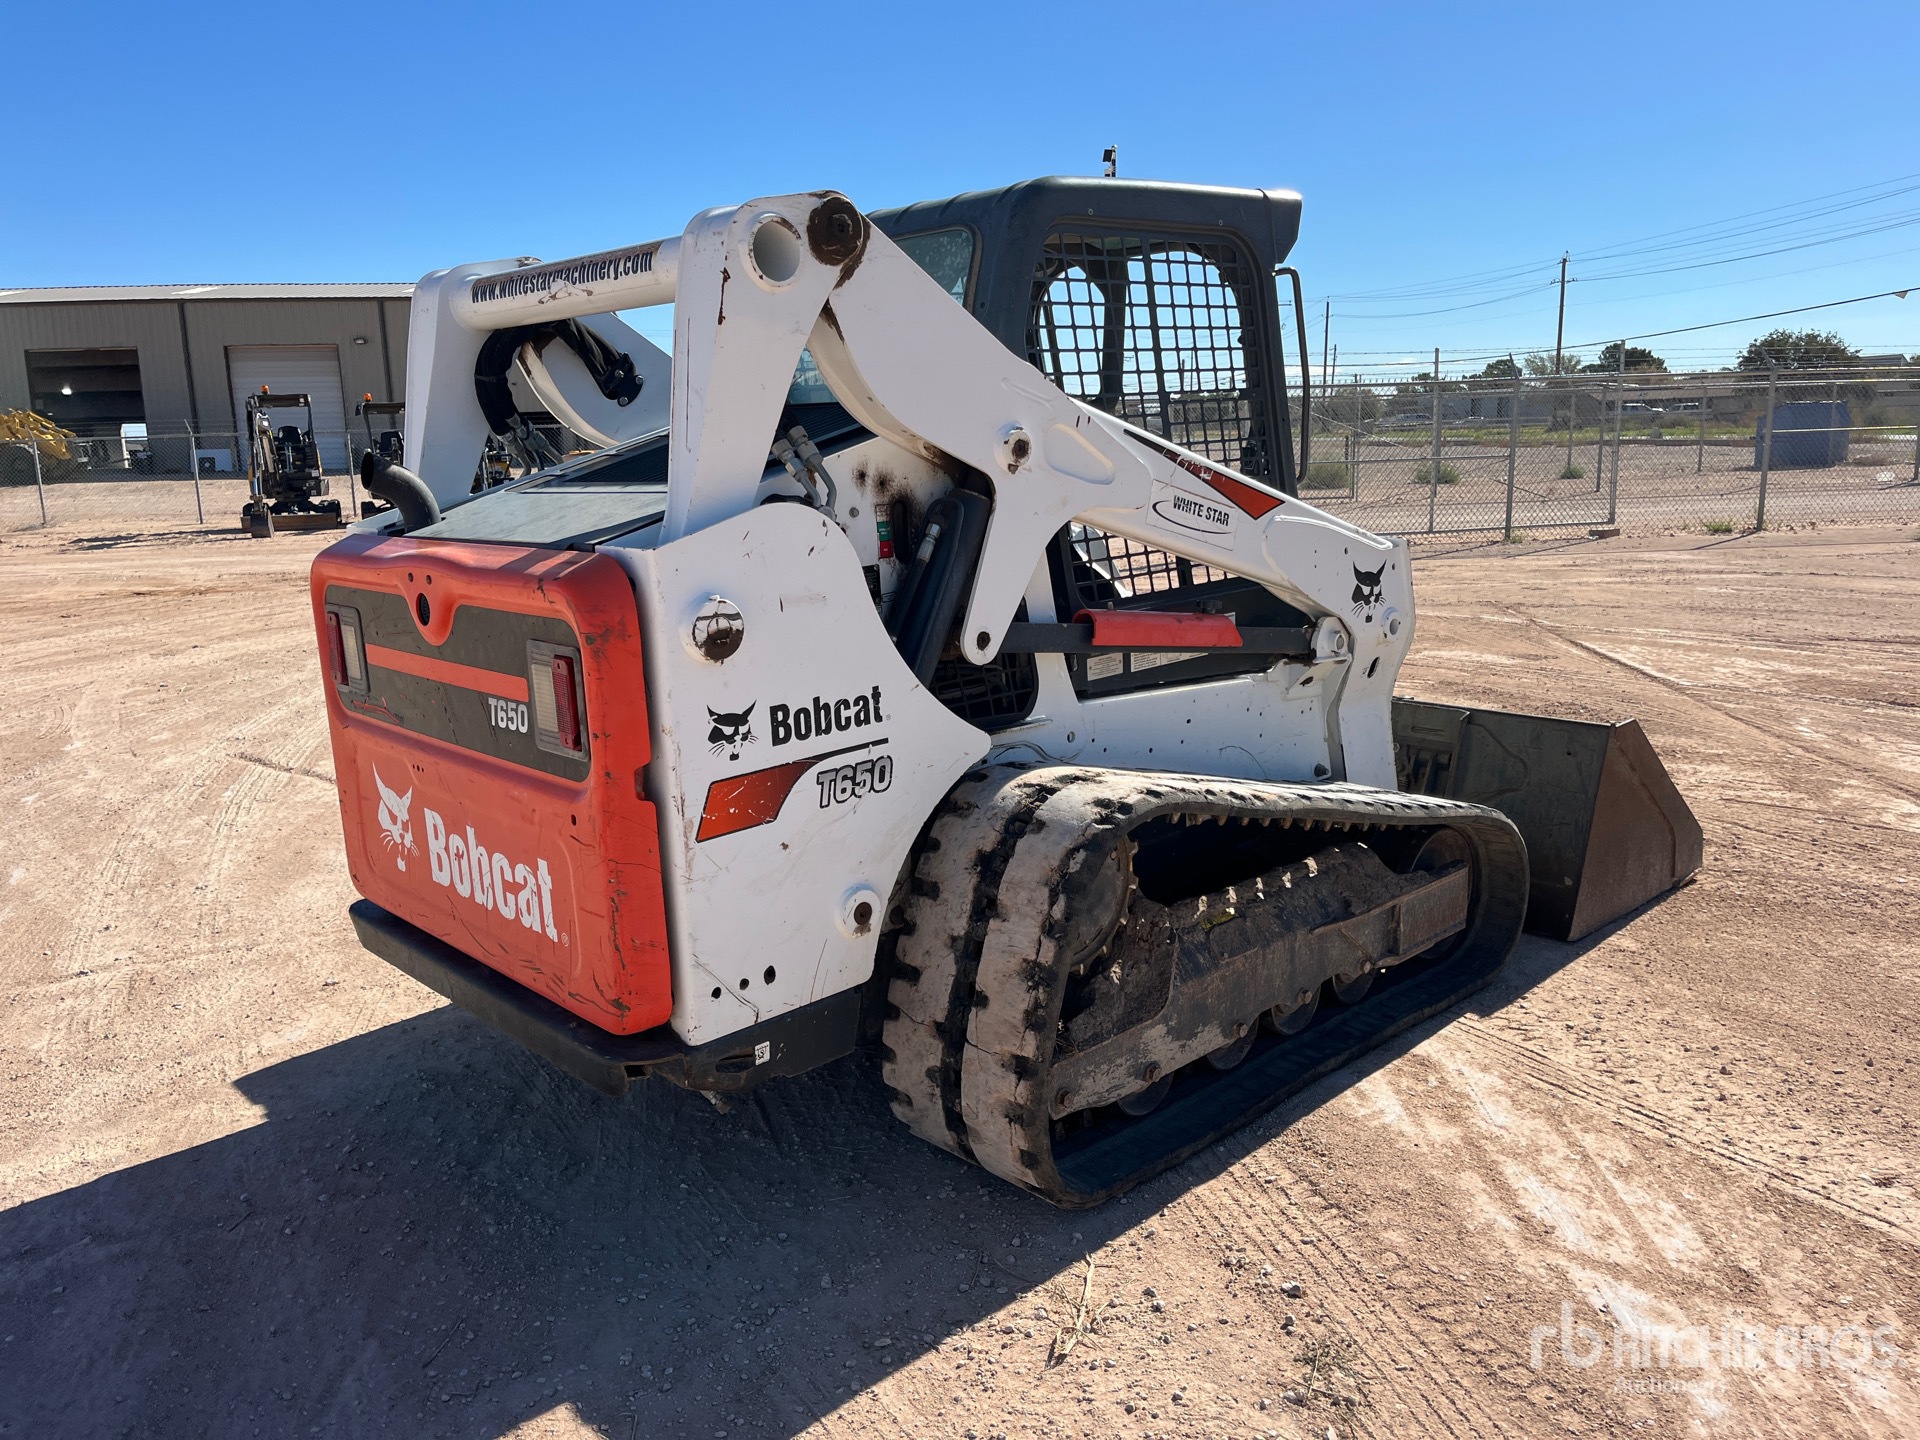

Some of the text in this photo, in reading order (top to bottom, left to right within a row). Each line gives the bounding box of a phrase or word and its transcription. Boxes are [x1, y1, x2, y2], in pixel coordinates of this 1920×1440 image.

[472, 250, 653, 303] www.whitestarmachinery.com
[1173, 495, 1230, 526] WHITE STAR
[488, 697, 528, 733] T650
[769, 685, 883, 747] Bobcat
[817, 755, 893, 809] T650
[424, 807, 558, 942] Bobcat
